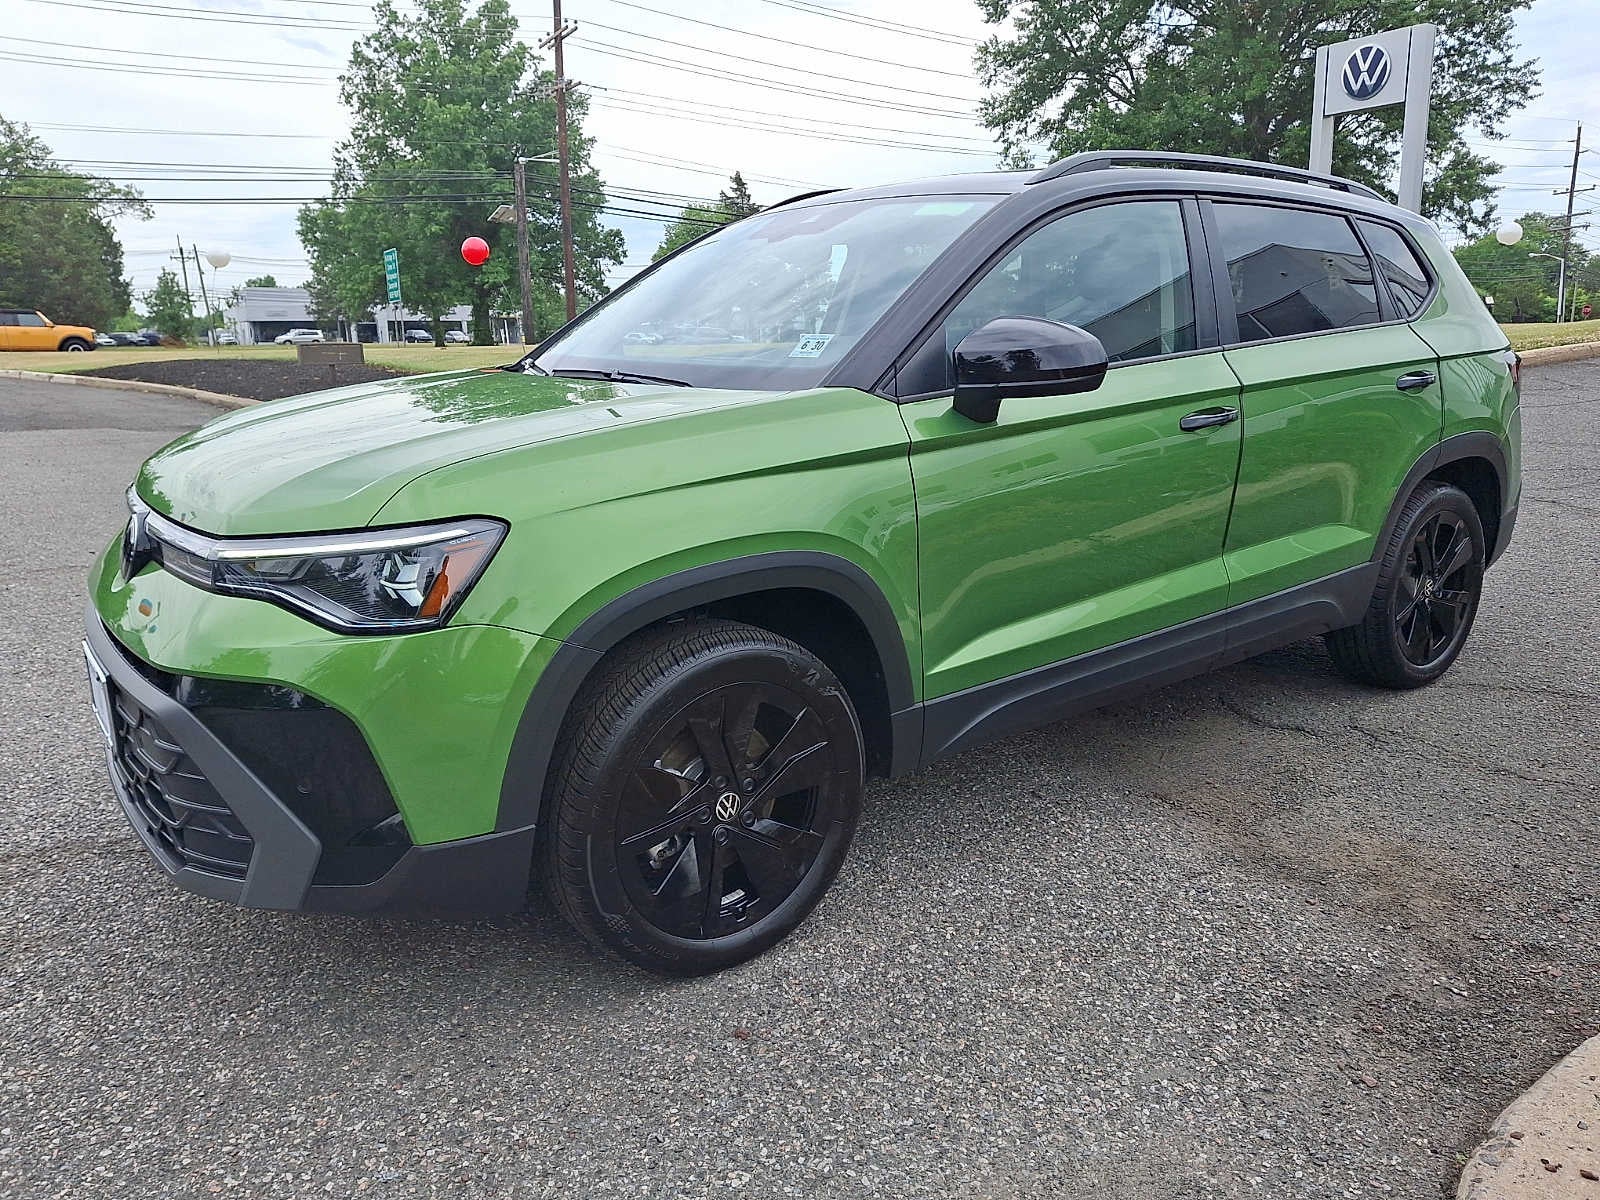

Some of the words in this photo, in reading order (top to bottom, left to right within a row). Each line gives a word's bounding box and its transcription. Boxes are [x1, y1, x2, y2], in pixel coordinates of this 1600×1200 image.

[1342, 45, 1390, 98] VW
[801, 340, 810, 349] 6
[716, 793, 740, 821] VW
